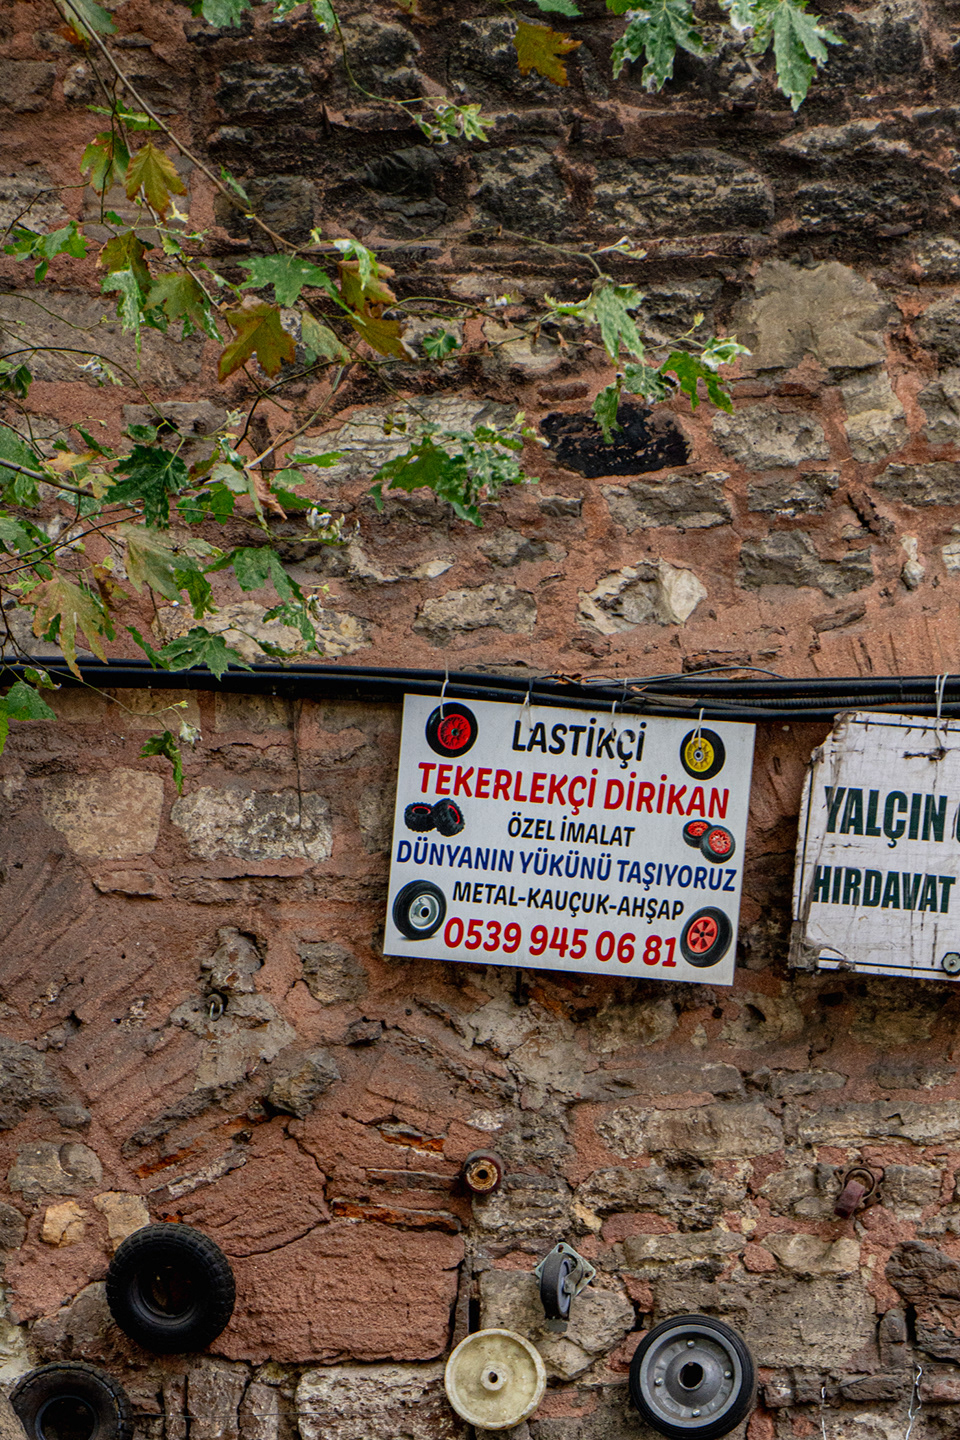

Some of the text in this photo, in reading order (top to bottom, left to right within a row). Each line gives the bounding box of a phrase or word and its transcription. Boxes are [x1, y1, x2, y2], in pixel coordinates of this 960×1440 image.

[512, 718, 648, 768] LASTİKÇİ
[418, 762, 730, 819] TEKERLEKÇİ DİRİKAN
[507, 811, 636, 848] ÖZEL İMALAT
[824, 786, 948, 849] YALÇIN
[396, 836, 738, 892] DÜNYANIN YÜKÜNÜ TAŞIYORUZ
[811, 865, 956, 914] HIRDAVAT
[452, 881, 685, 924] METAL-KAUÇUK-AHŞAP
[443, 916, 678, 968] 0539 945 06 81
